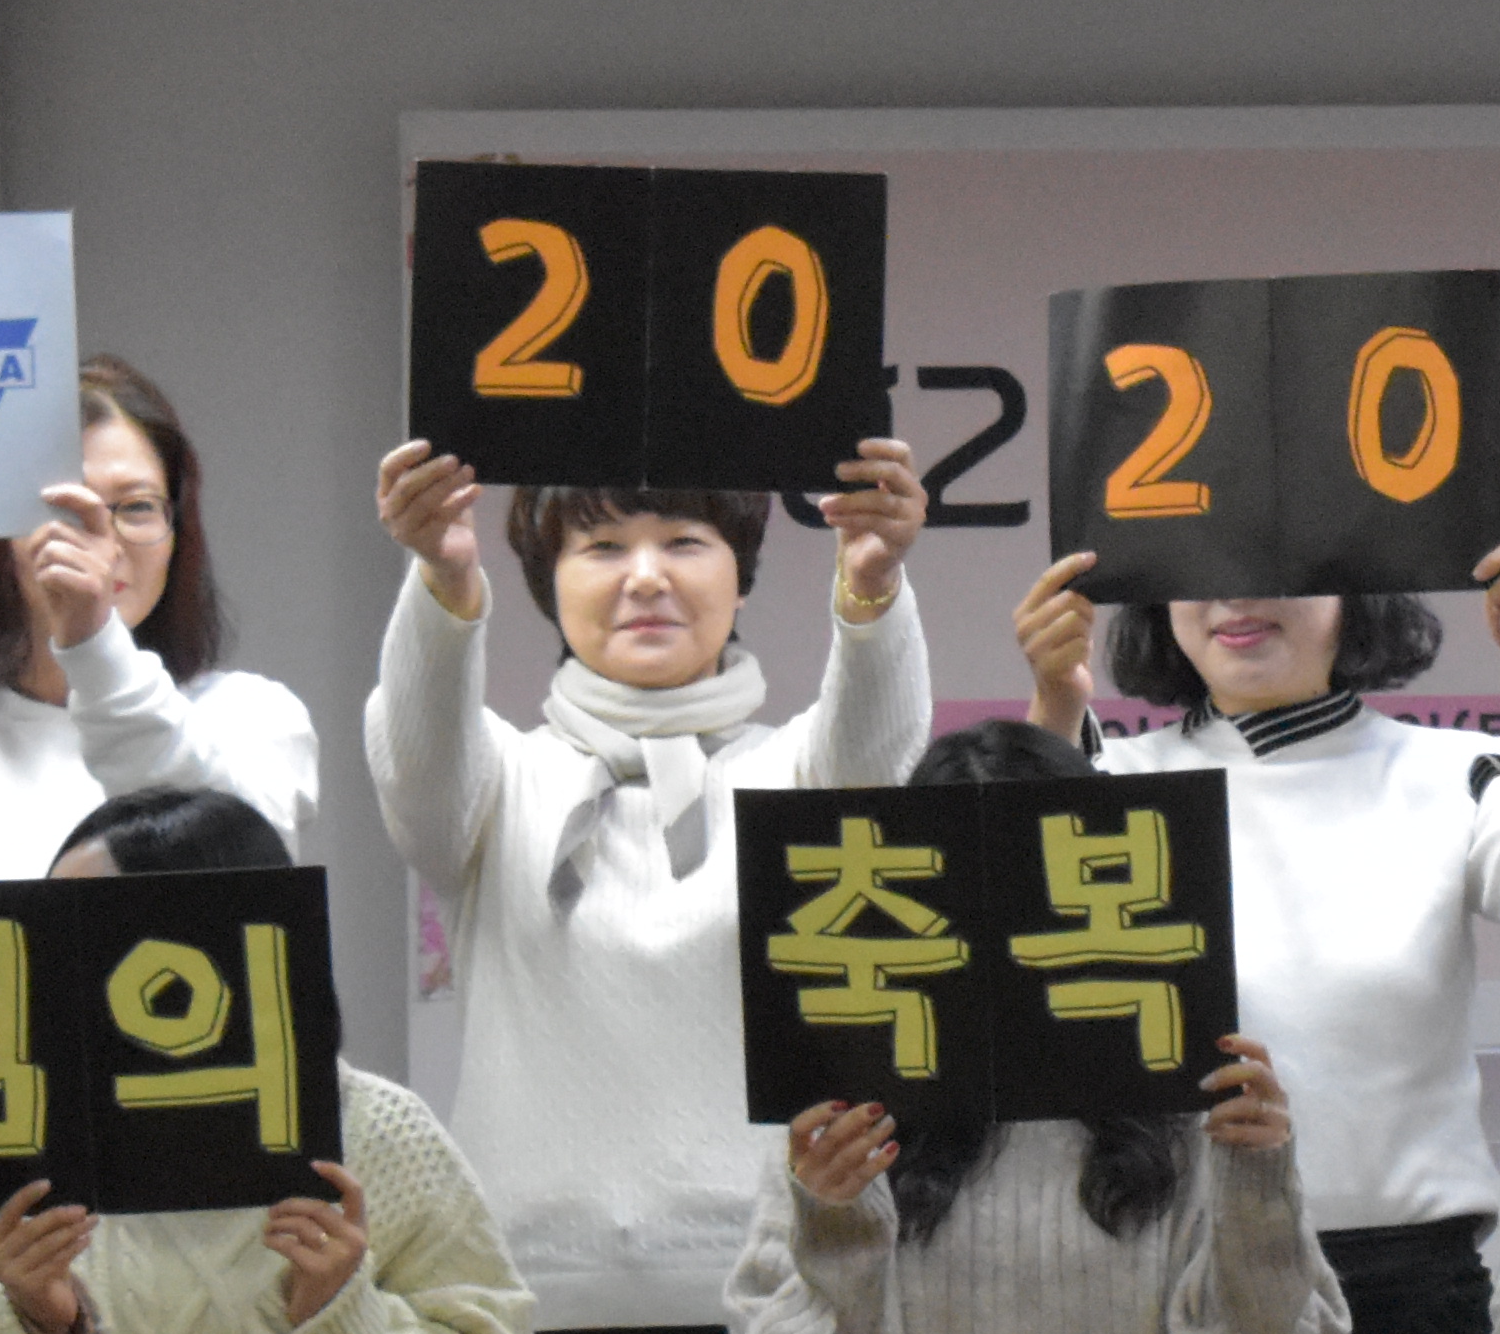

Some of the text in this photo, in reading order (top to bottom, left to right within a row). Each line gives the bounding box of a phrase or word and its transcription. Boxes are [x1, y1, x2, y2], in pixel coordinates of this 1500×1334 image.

[472, 217, 830, 406] 20
[1102, 325, 1463, 521] 20
[767, 809, 1206, 1078] 축복
